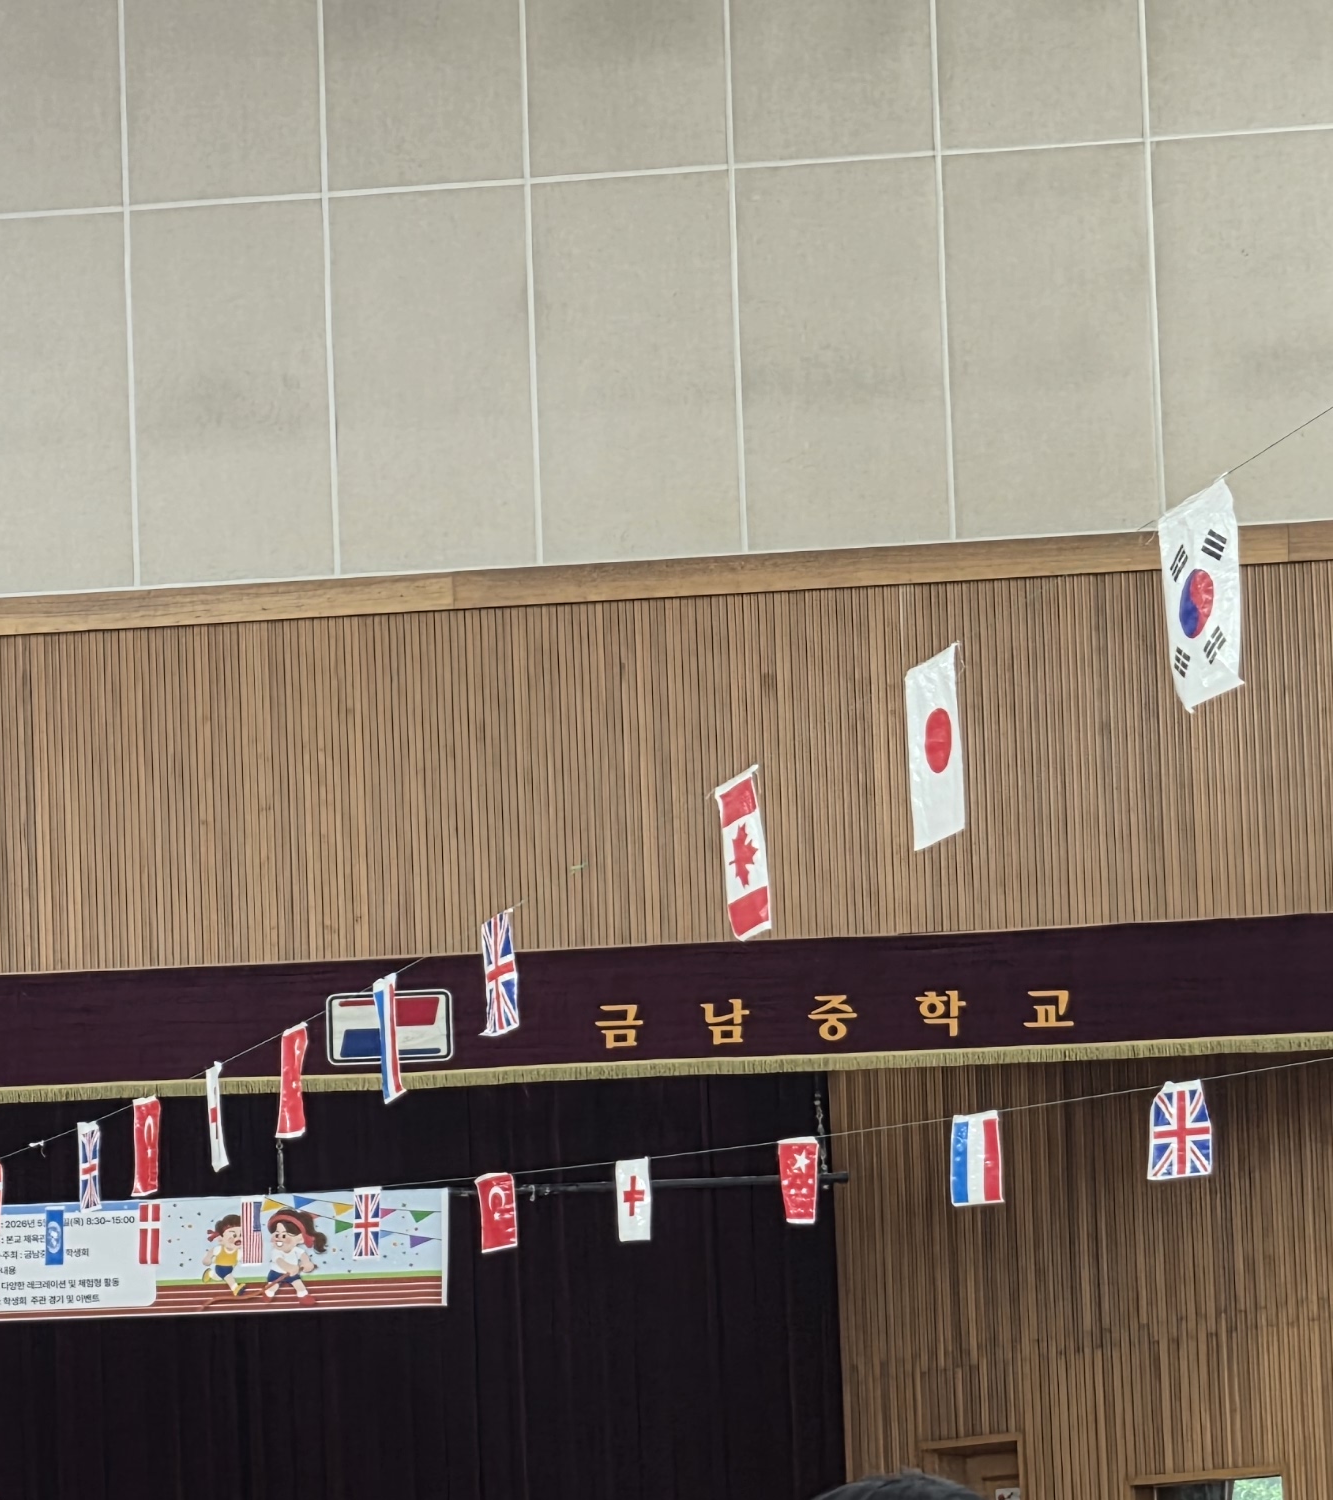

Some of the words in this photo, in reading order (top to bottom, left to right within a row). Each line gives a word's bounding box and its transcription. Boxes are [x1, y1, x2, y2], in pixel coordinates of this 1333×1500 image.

[595, 989, 1075, 1049] 금남중학교
[5, 1219, 35, 1229] 2026년
[6, 1235, 22, 1245] 본교
[66, 1247, 90, 1258] 학생회
[1, 1281, 25, 1291] 다양한
[68, 1279, 77, 1289] 및
[103, 1277, 120, 1287] 활동
[3, 1296, 27, 1306] 학생회
[30, 1295, 47, 1305] 주관
[48, 1294, 64, 1305] 경기
[66, 1294, 74, 1304] 및
[75, 1293, 101, 1304] 이벤트
